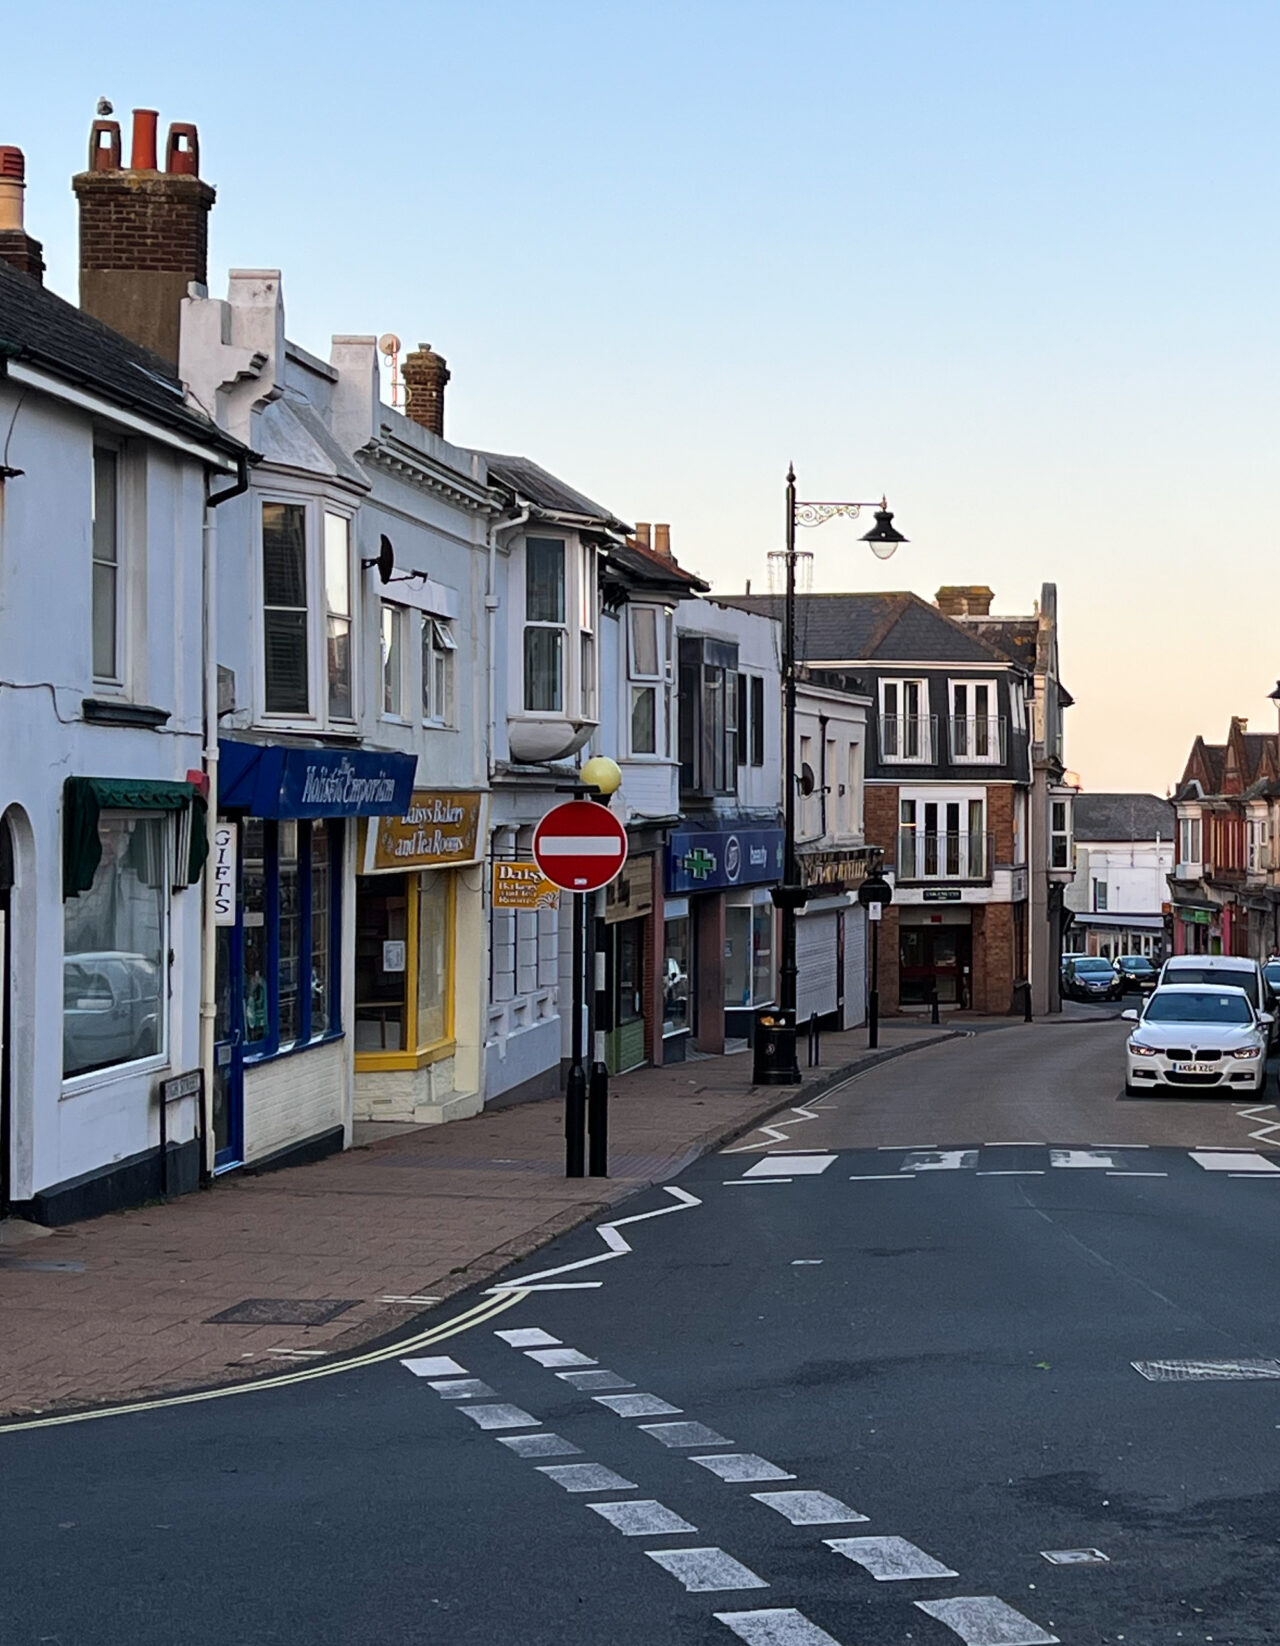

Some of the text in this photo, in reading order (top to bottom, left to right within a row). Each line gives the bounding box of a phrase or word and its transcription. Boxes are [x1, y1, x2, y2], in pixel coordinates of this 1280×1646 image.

[302, 766, 395, 810] Holistic Emporium
[433, 799, 464, 828] Bakery
[395, 833, 416, 856] and
[417, 830, 432, 854] Tea
[215, 830, 230, 914] GIFTS
